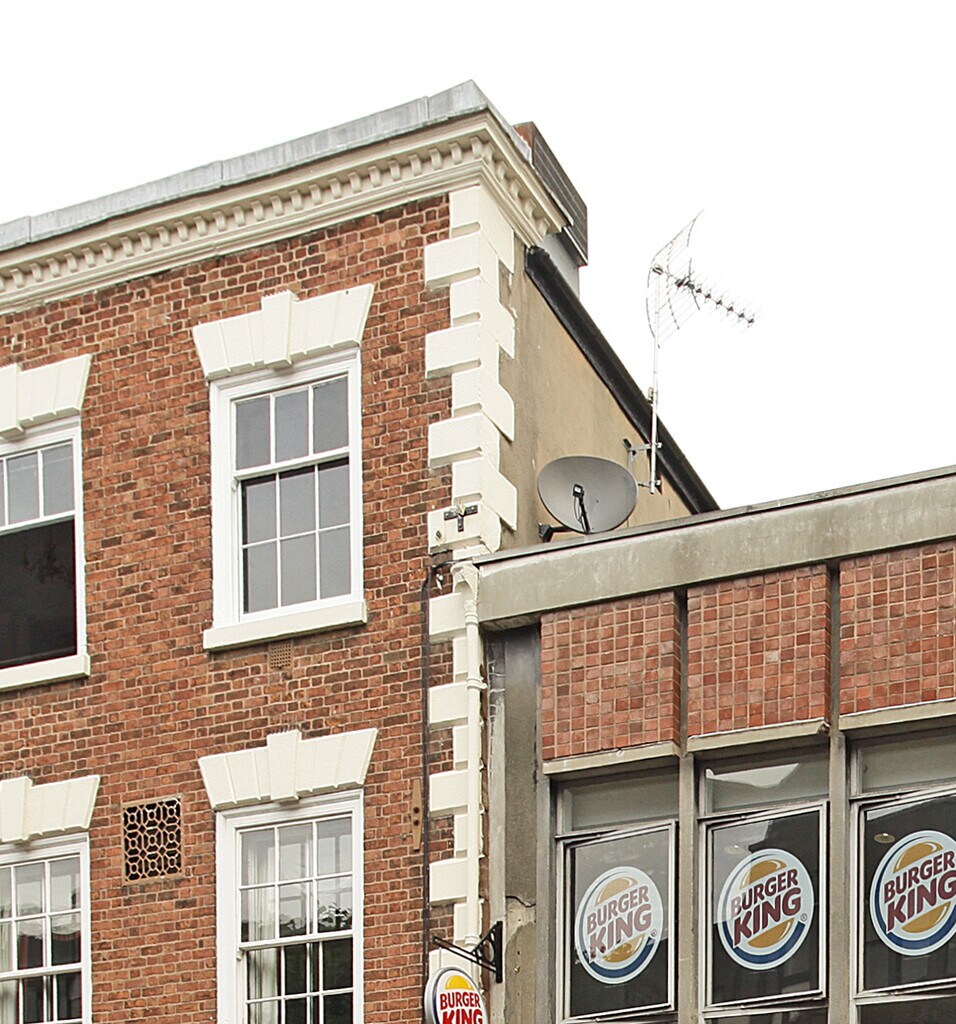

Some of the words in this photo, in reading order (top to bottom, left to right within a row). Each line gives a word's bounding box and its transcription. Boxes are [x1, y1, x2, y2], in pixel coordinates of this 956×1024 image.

[730, 868, 799, 917] BURGER
[884, 850, 955, 904] BURGER
[586, 885, 649, 935] BURGER
[589, 904, 652, 960] KING
[733, 887, 801, 946] KING
[440, 991, 480, 1010] BURGER
